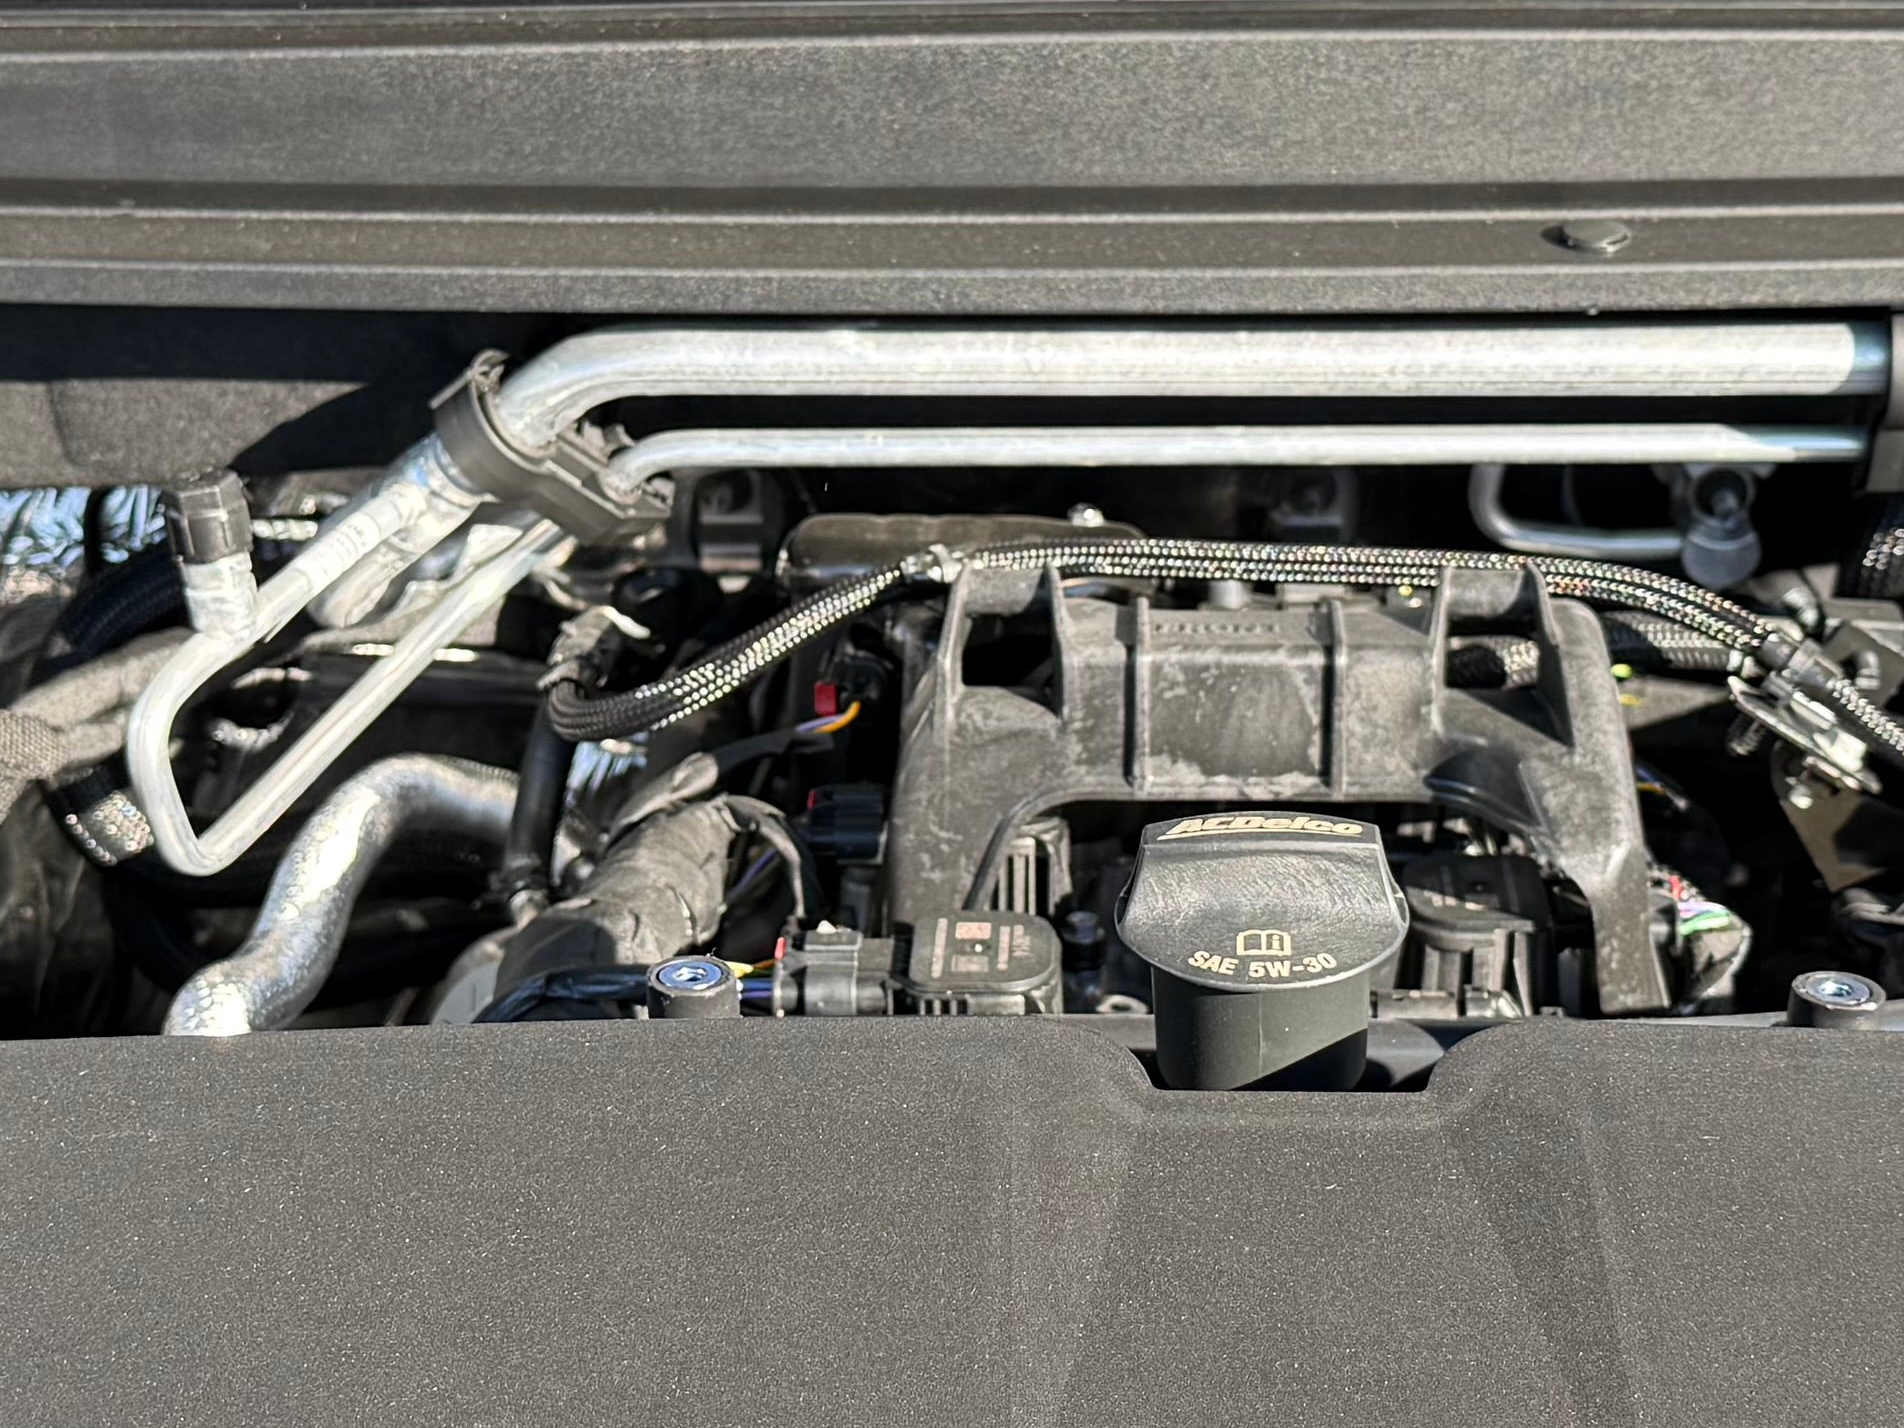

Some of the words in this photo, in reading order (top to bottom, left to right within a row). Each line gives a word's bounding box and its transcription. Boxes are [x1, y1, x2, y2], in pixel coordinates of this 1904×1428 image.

[1164, 816, 1363, 836] ACDelco
[1187, 950, 1239, 976] SAE
[1248, 952, 1337, 978] 5W-30
